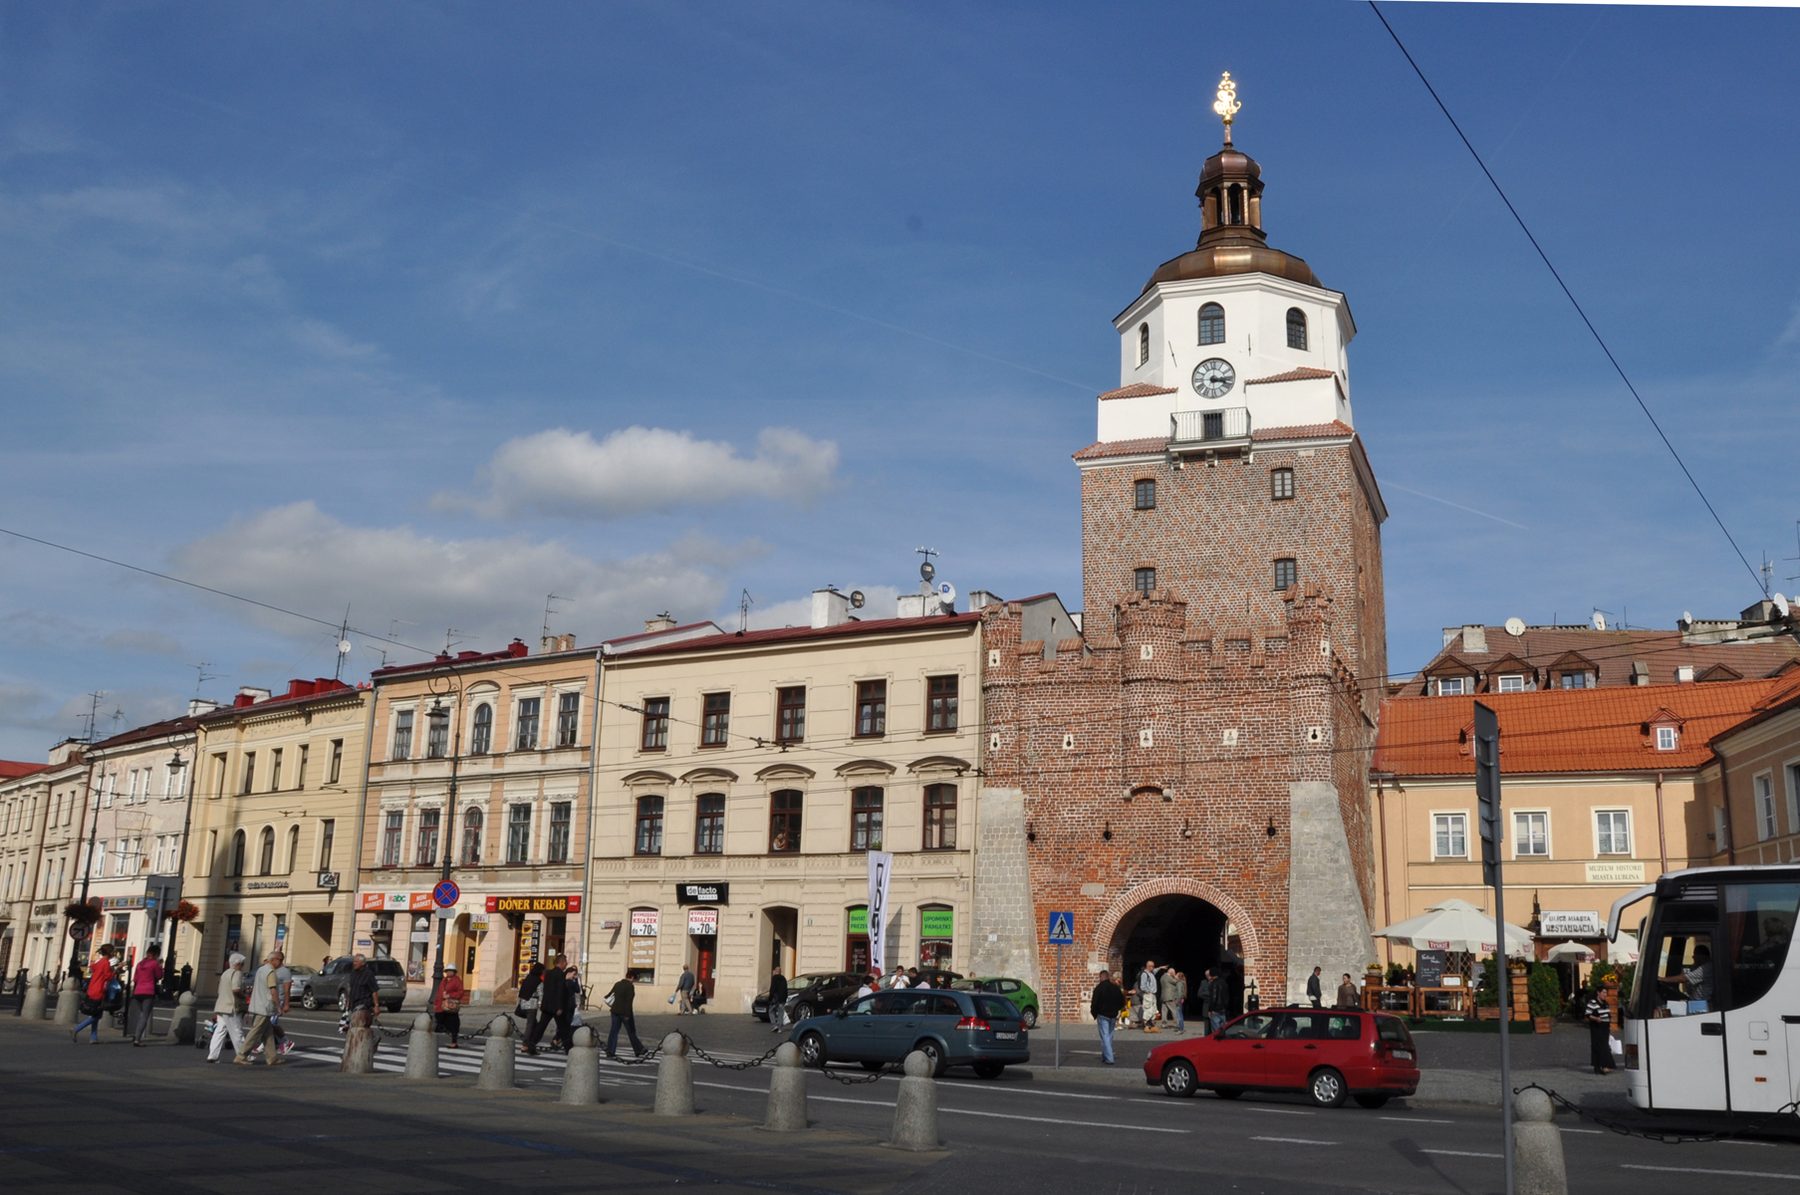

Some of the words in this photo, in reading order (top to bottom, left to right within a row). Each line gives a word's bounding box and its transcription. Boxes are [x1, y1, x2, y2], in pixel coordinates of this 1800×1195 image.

[698, 886, 717, 894] facto
[498, 898, 530, 911] DÖNER
[533, 899, 566, 911] KEBAB
